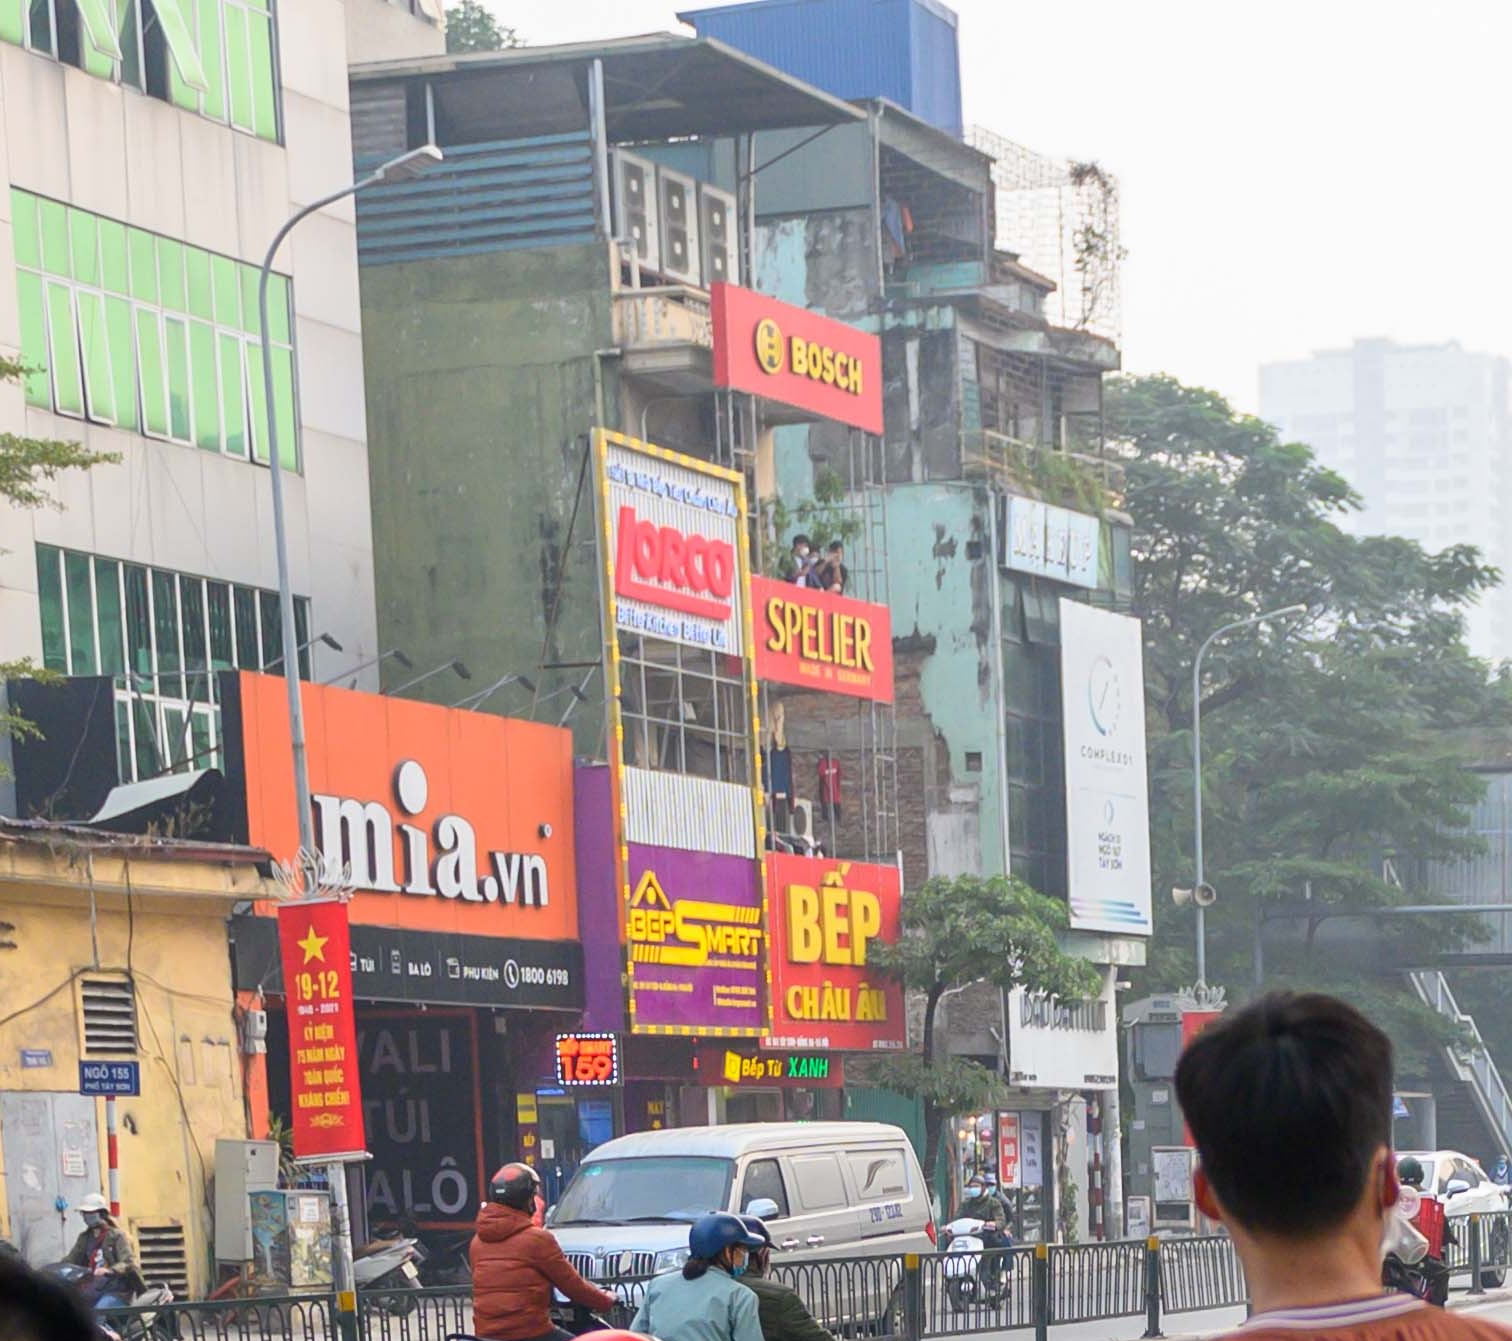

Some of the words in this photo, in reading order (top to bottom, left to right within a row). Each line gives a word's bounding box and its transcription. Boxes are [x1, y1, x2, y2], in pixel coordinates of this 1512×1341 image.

[791, 336, 863, 395] BOSCH
[767, 596, 874, 672] SPELIER
[785, 862, 881, 967] BẾP
[295, 971, 340, 1000] 19-12
[520, 965, 544, 984] 1800
[786, 980, 850, 1021] CHÂU
[112, 1066, 129, 1079] 155
[742, 1056, 765, 1080] Bếp
[788, 1056, 828, 1078] XANH
